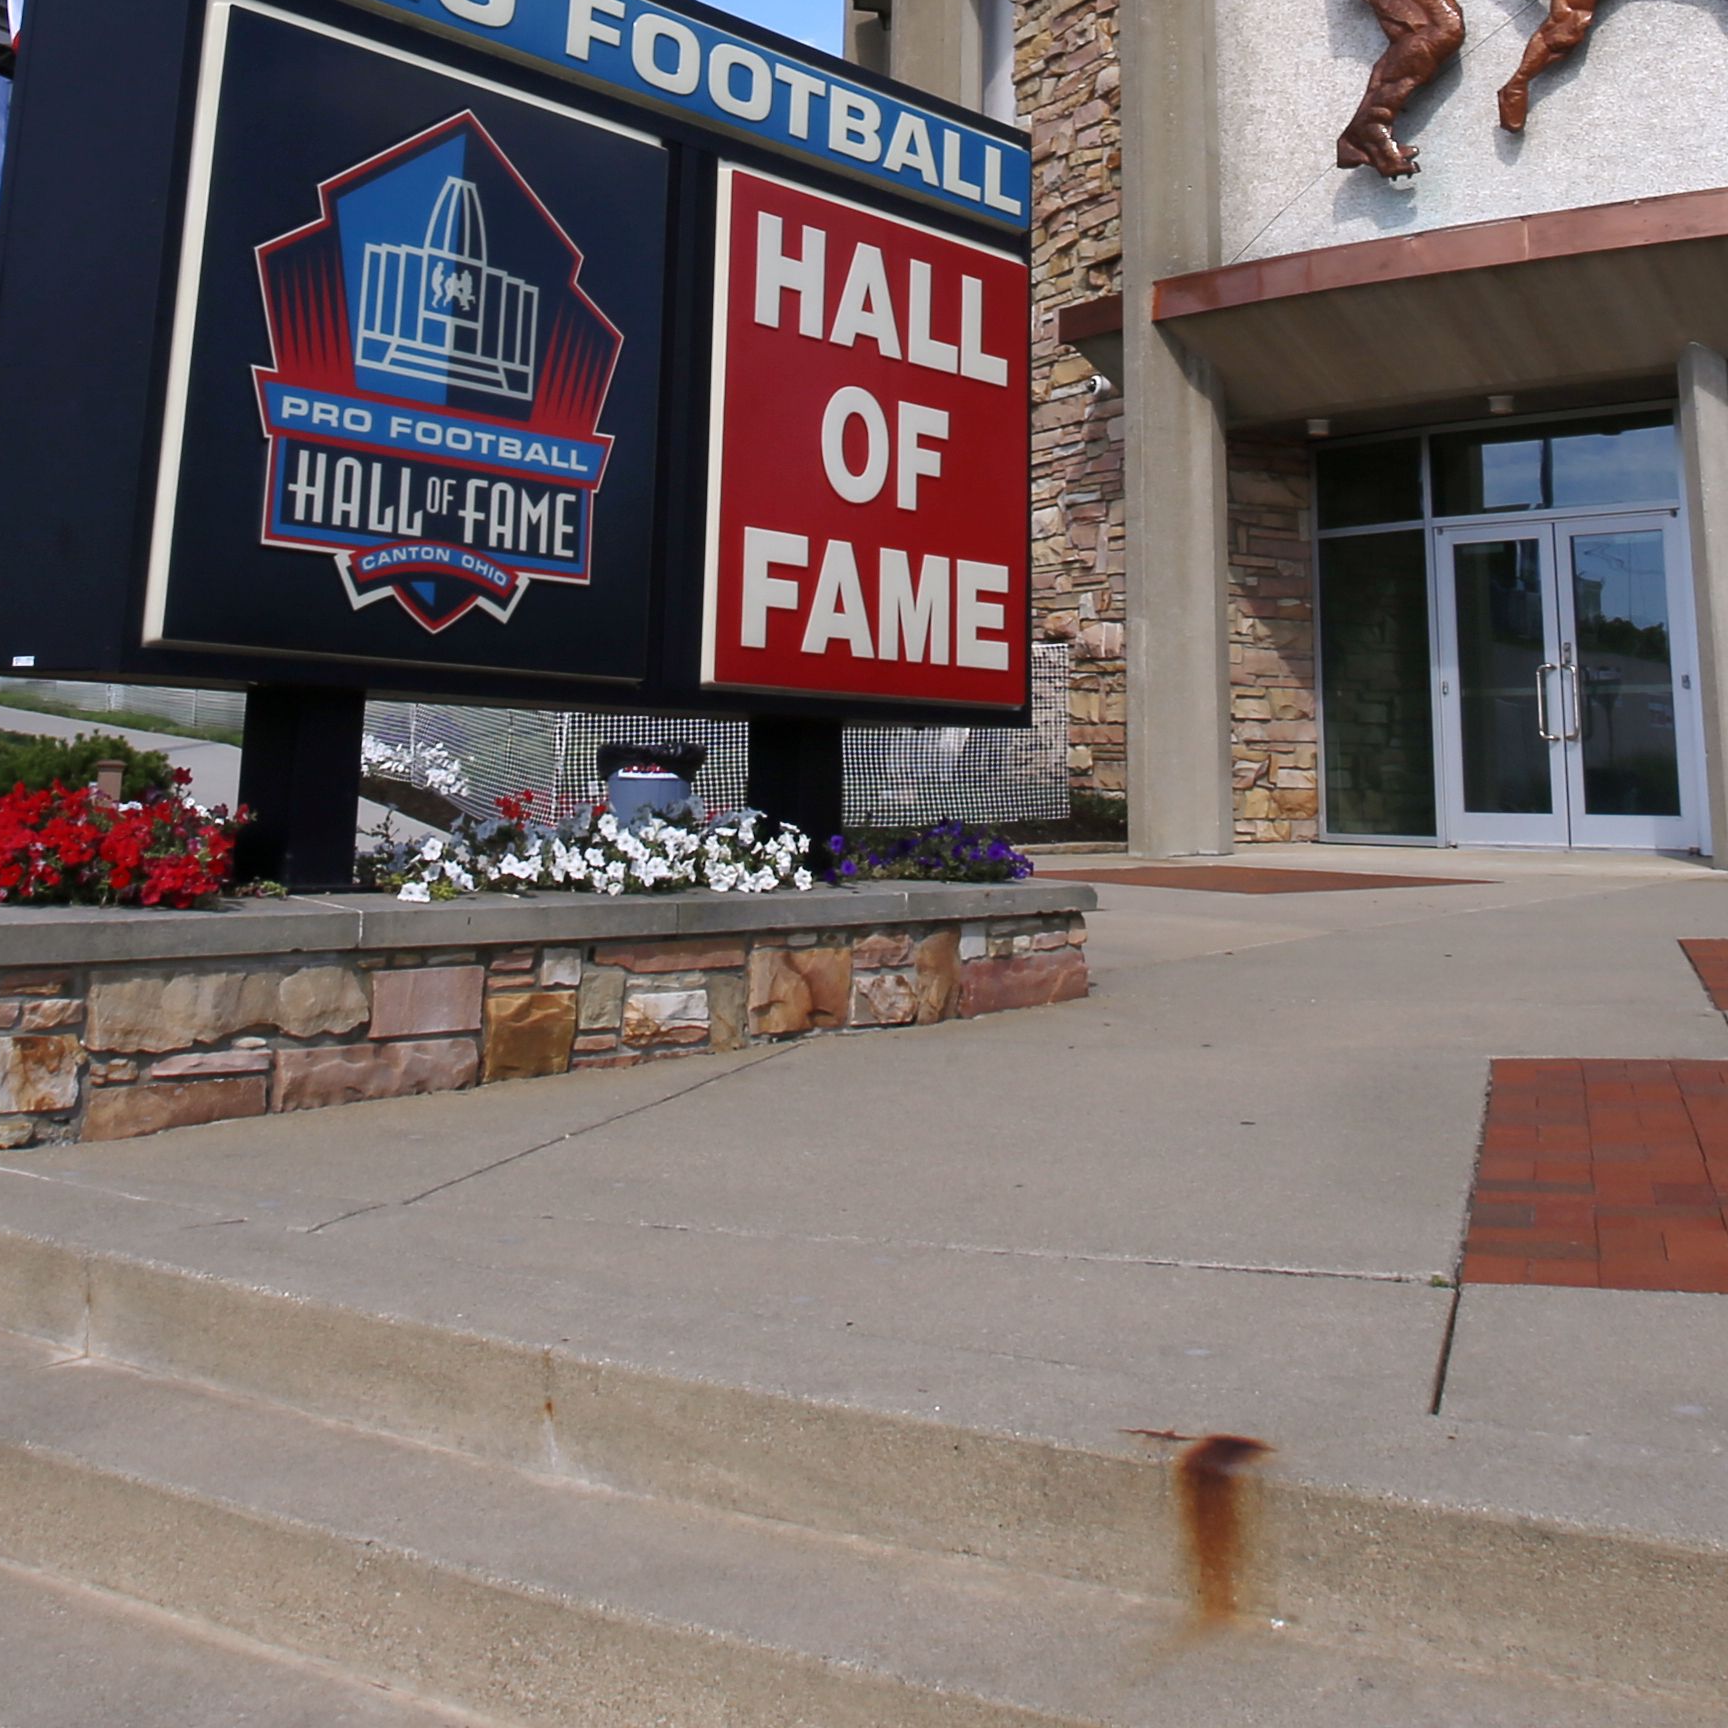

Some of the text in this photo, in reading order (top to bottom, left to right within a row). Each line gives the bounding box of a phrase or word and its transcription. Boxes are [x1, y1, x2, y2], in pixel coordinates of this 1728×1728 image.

[754, 211, 1008, 388] HALL
[281, 396, 588, 472] PRO FOOTBALL
[821, 385, 949, 511] OF
[288, 449, 576, 558] HALL OF FAME
[362, 546, 507, 587] CANTON OHIO
[740, 526, 1009, 671] FAME
